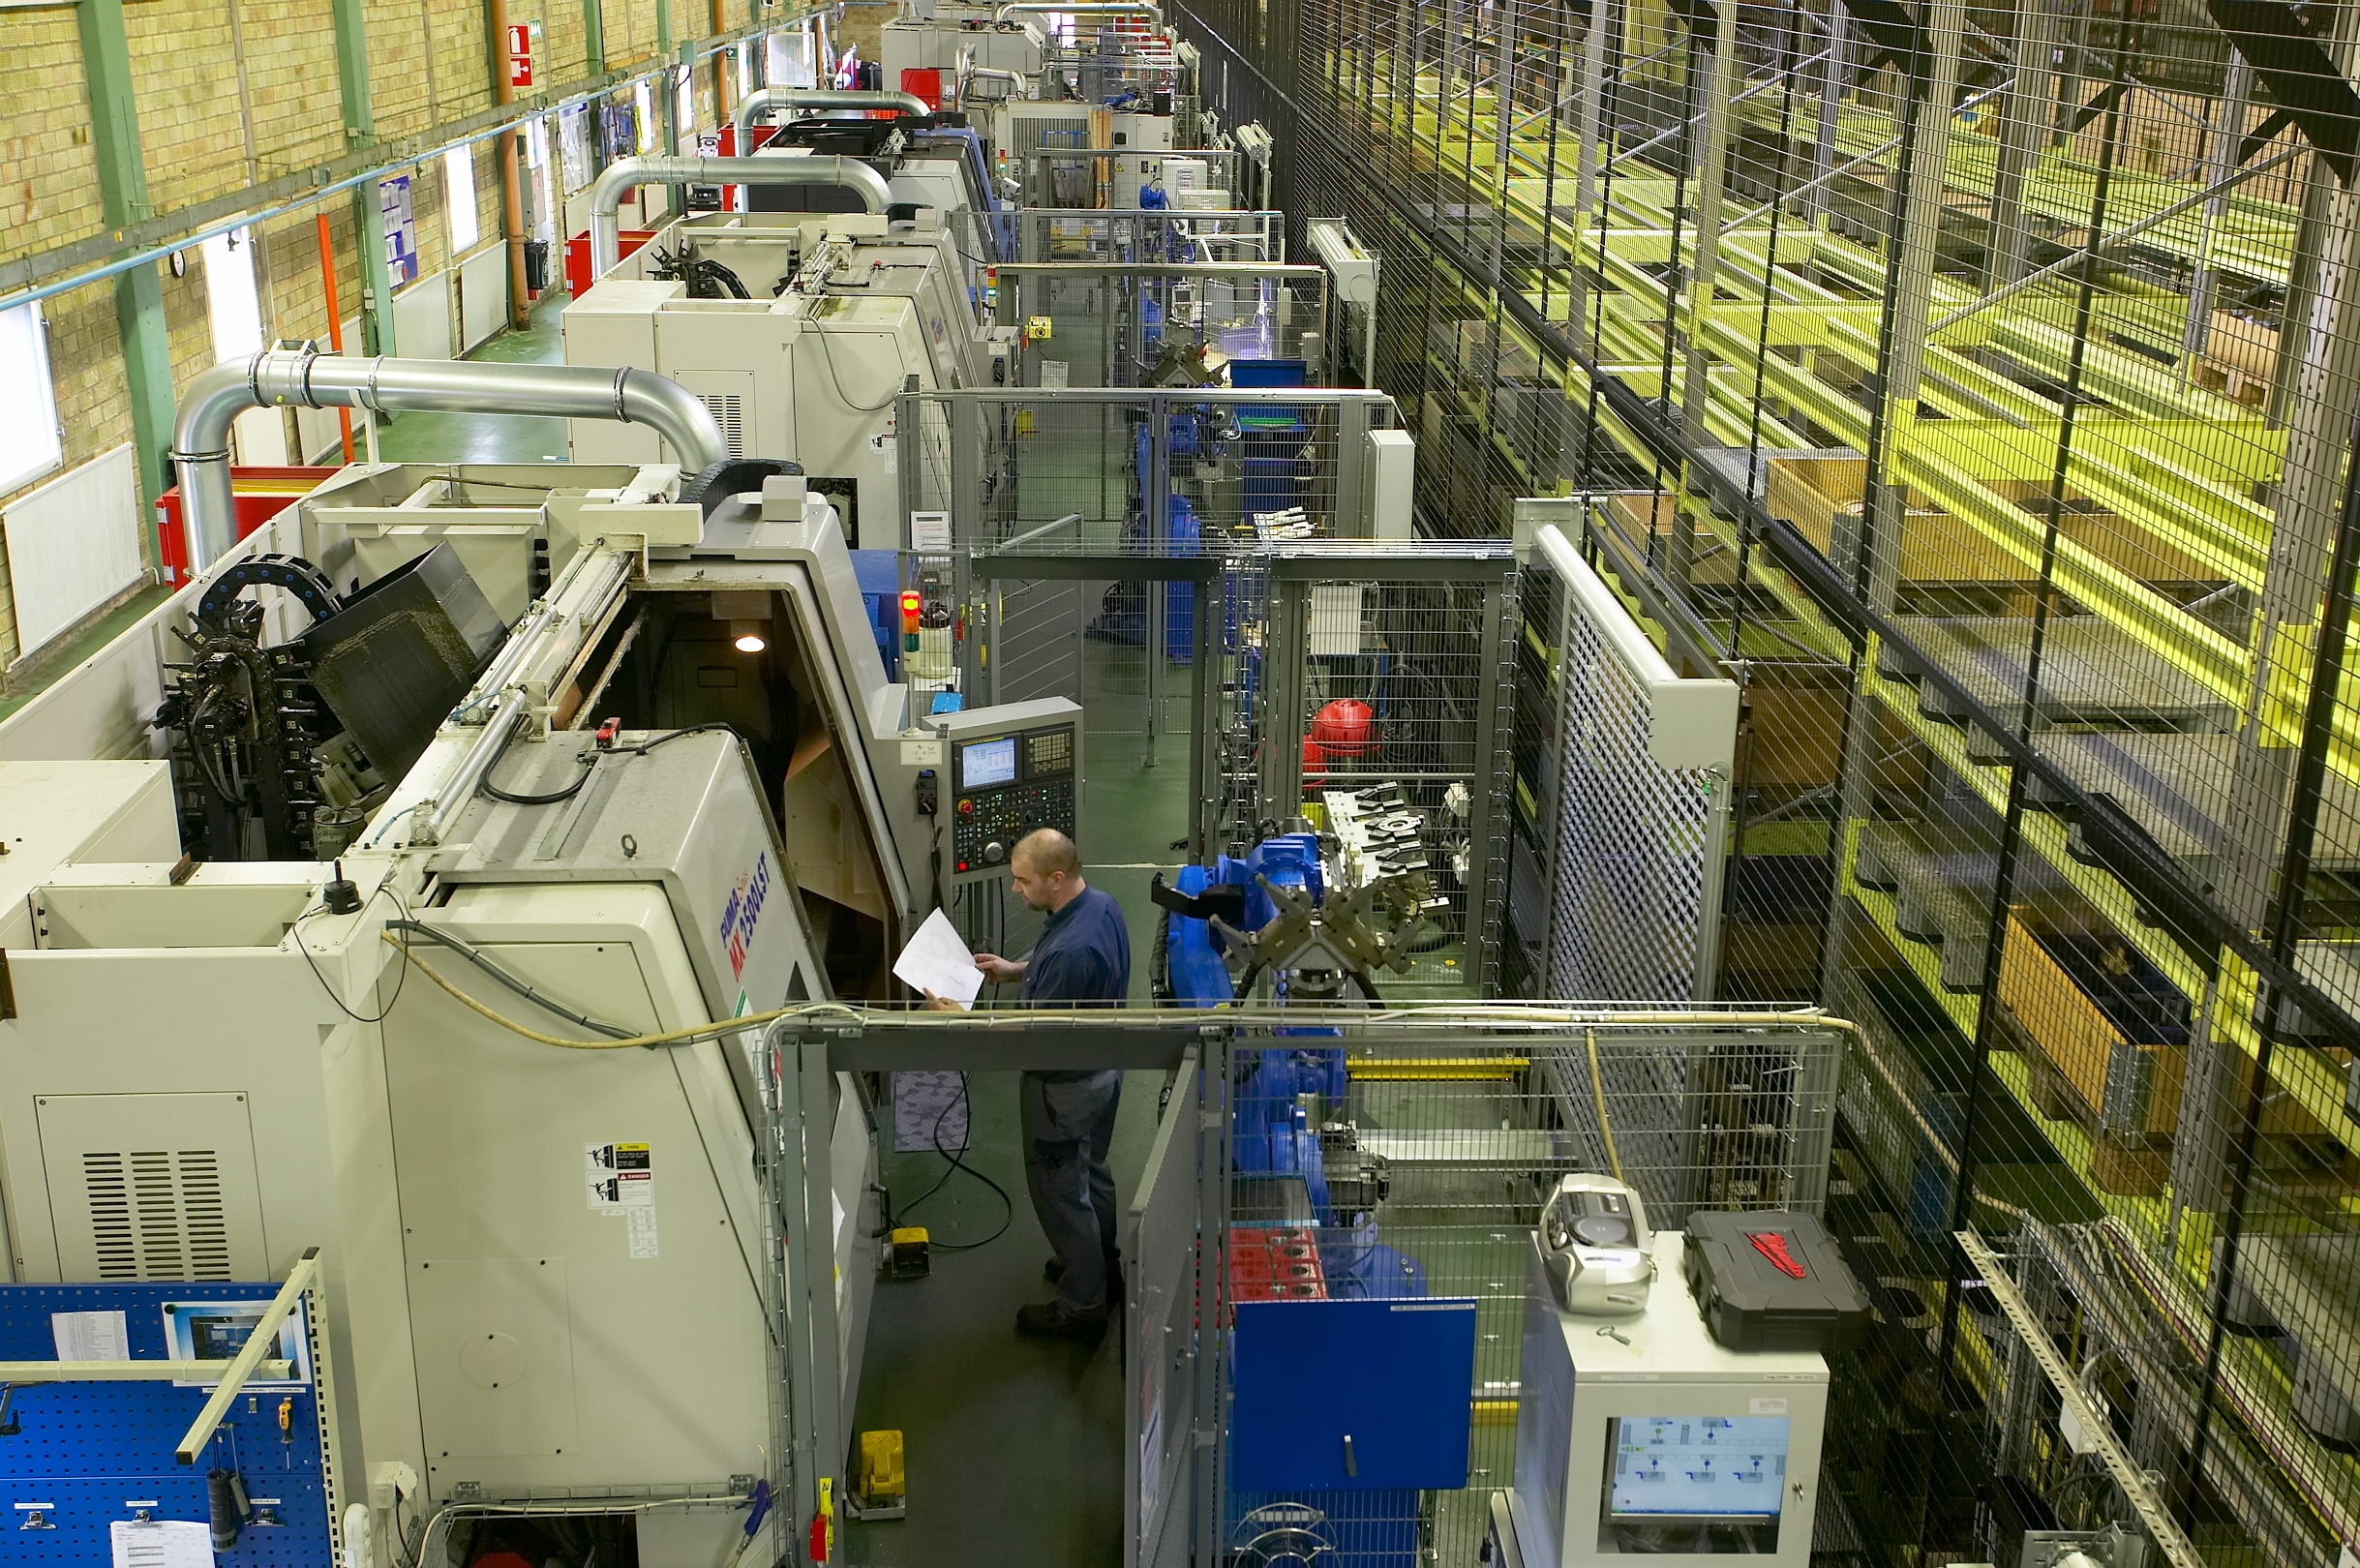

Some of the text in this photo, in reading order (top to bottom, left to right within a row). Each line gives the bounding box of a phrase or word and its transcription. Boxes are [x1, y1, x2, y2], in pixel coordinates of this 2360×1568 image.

[720, 888, 741, 949] PUMA
[729, 851, 771, 983] MX 2500LST
